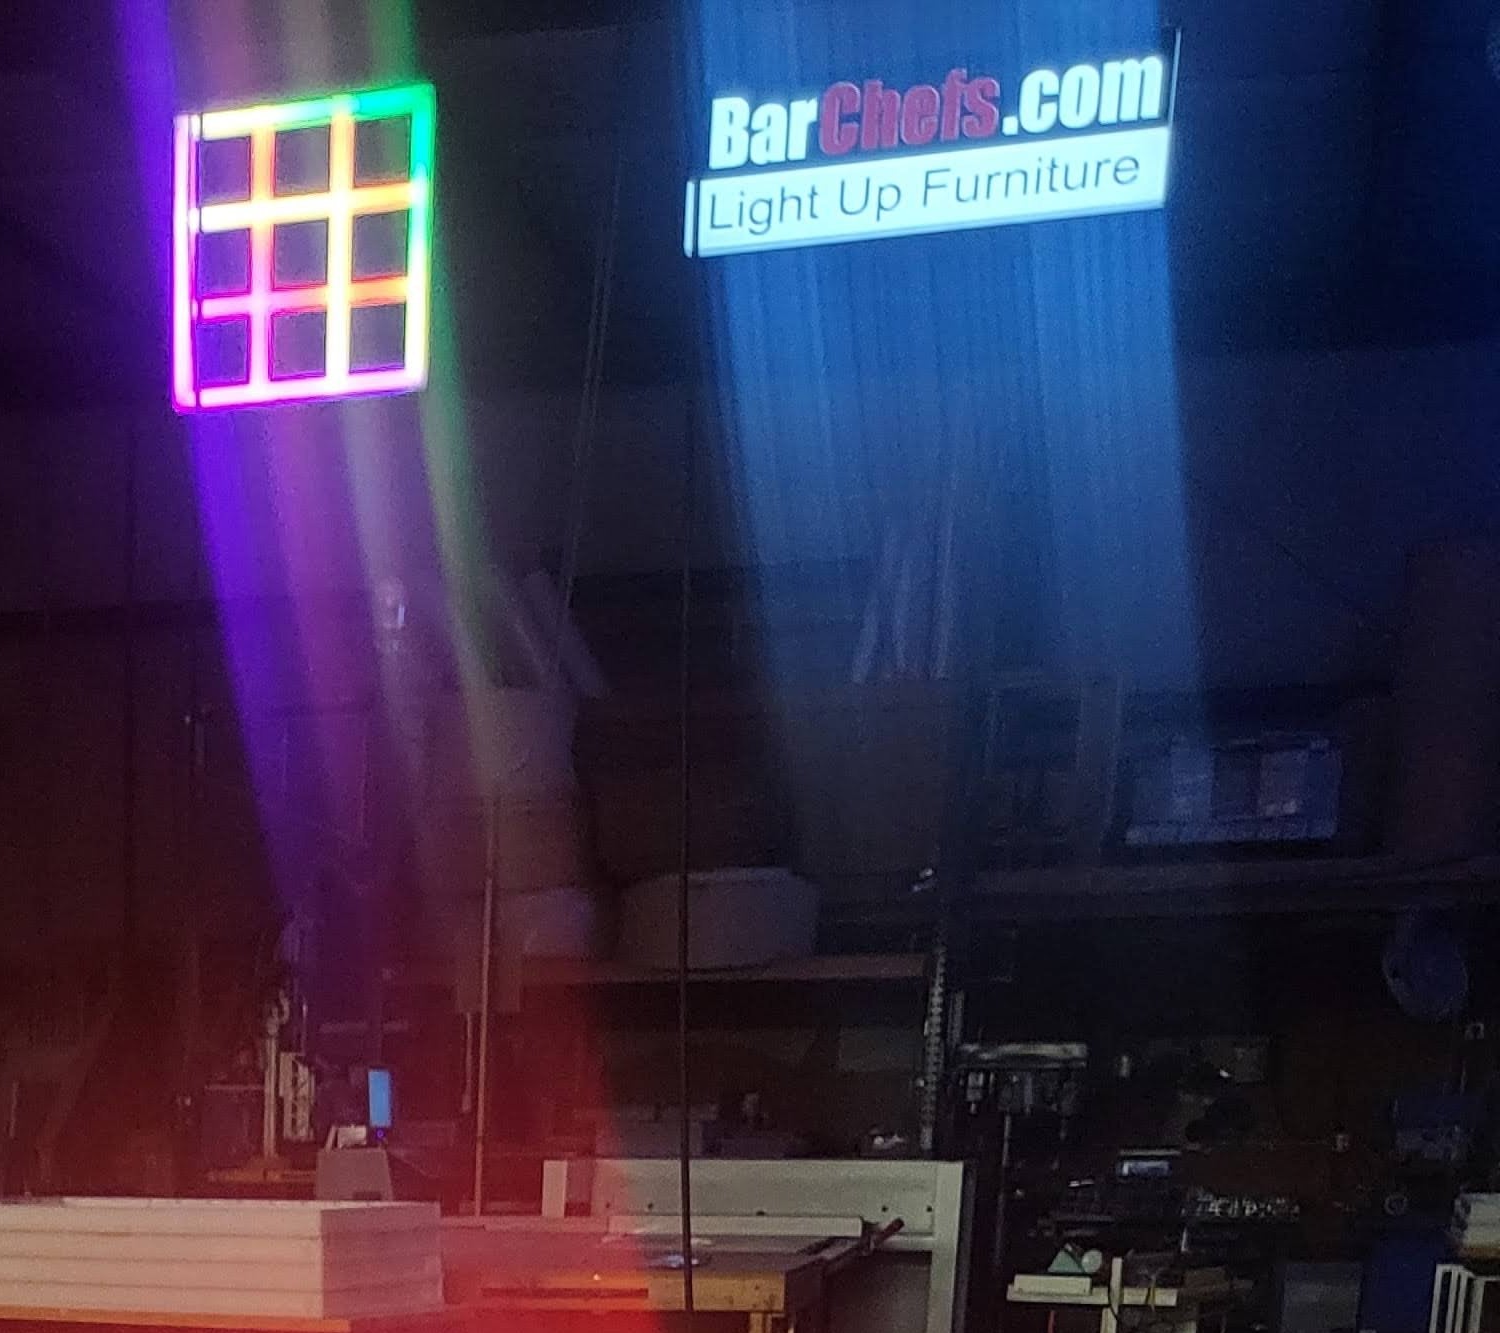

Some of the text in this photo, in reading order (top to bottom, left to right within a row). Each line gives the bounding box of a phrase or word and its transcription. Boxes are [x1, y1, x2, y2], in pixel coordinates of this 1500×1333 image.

[709, 55, 1164, 170] BarChefs.com
[709, 154, 1141, 235] Light Up Furniture
